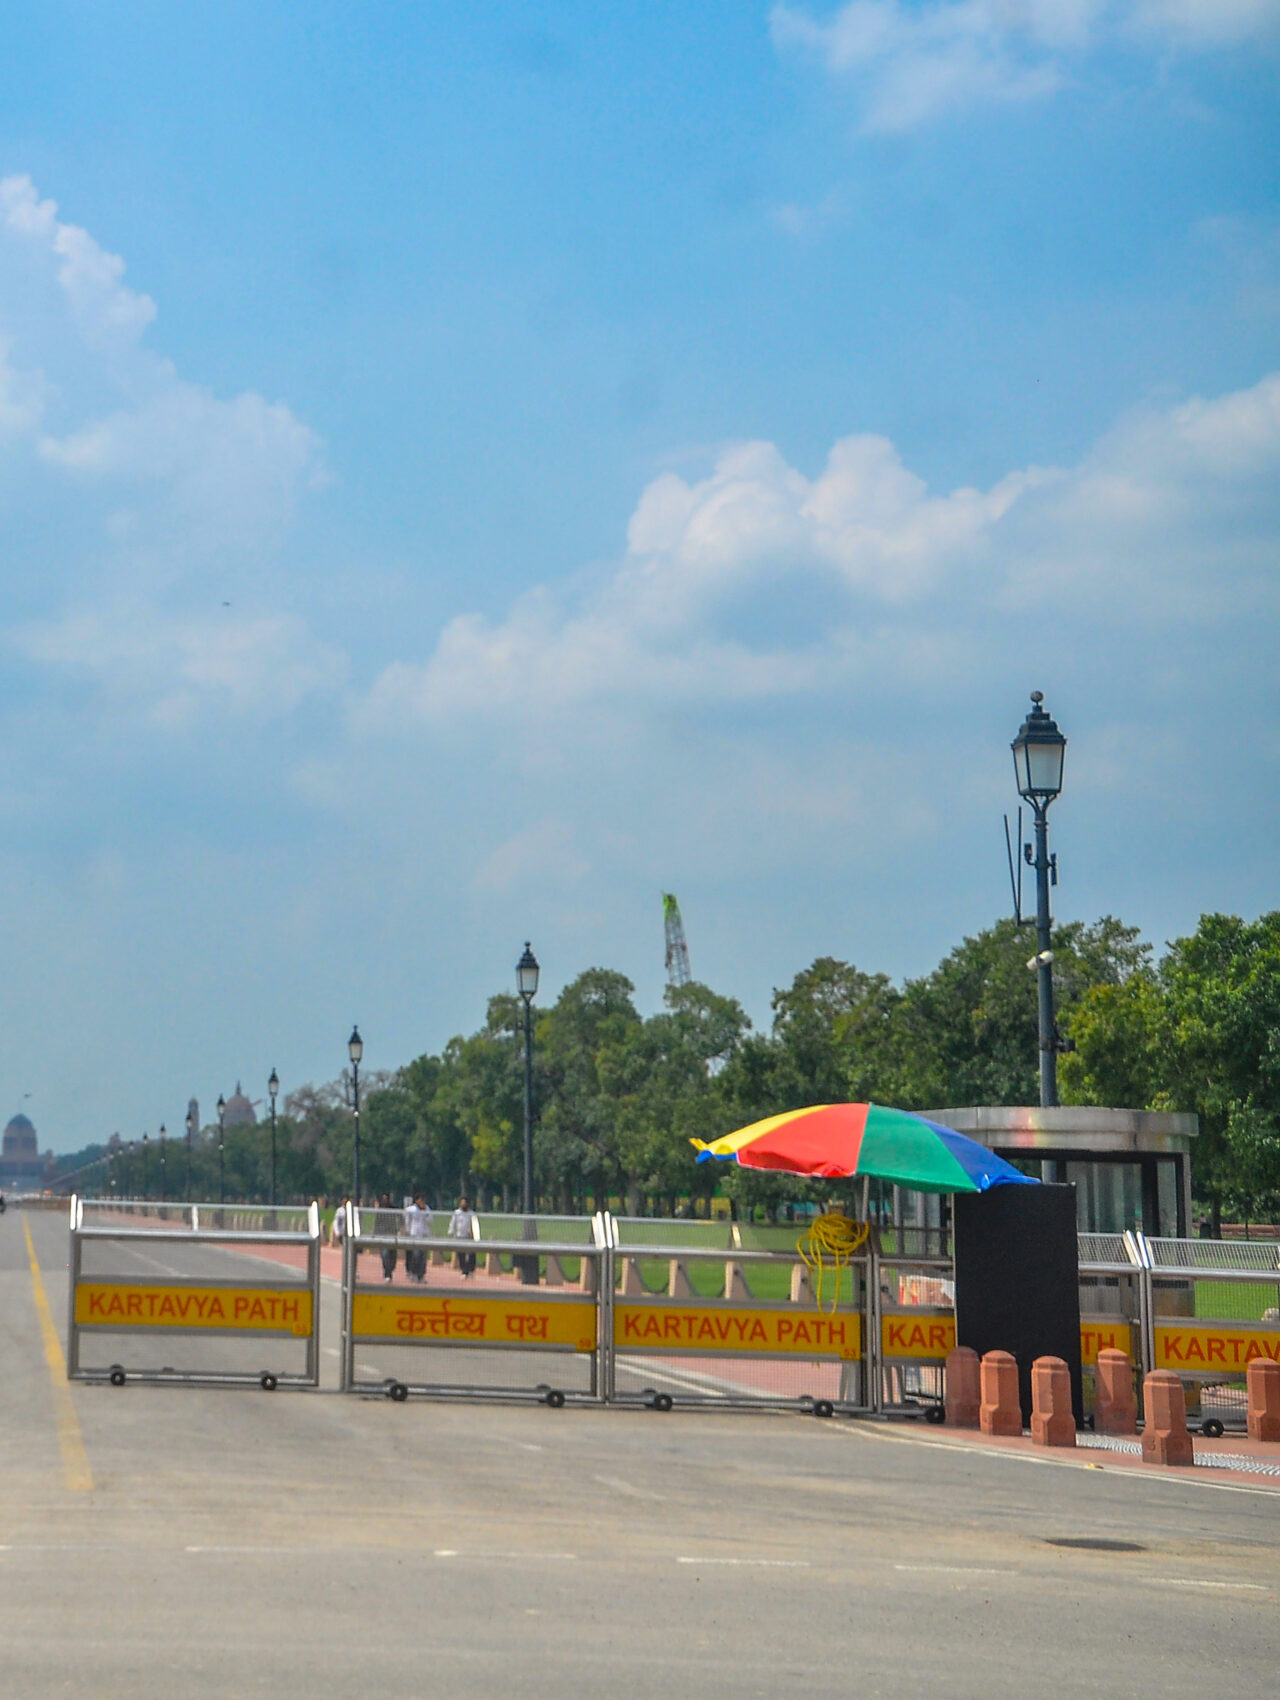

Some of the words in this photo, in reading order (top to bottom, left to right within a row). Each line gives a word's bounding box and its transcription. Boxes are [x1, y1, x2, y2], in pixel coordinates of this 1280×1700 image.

[89, 1293, 225, 1319] KARTAVYA
[234, 1297, 299, 1321] PATH
[506, 1315, 549, 1339] पथ
[624, 1314, 768, 1342] KARTAVYA
[777, 1319, 846, 1345] PATH
[1081, 1332, 1115, 1357] TH
[1164, 1336, 1280, 1363] KARTAV
